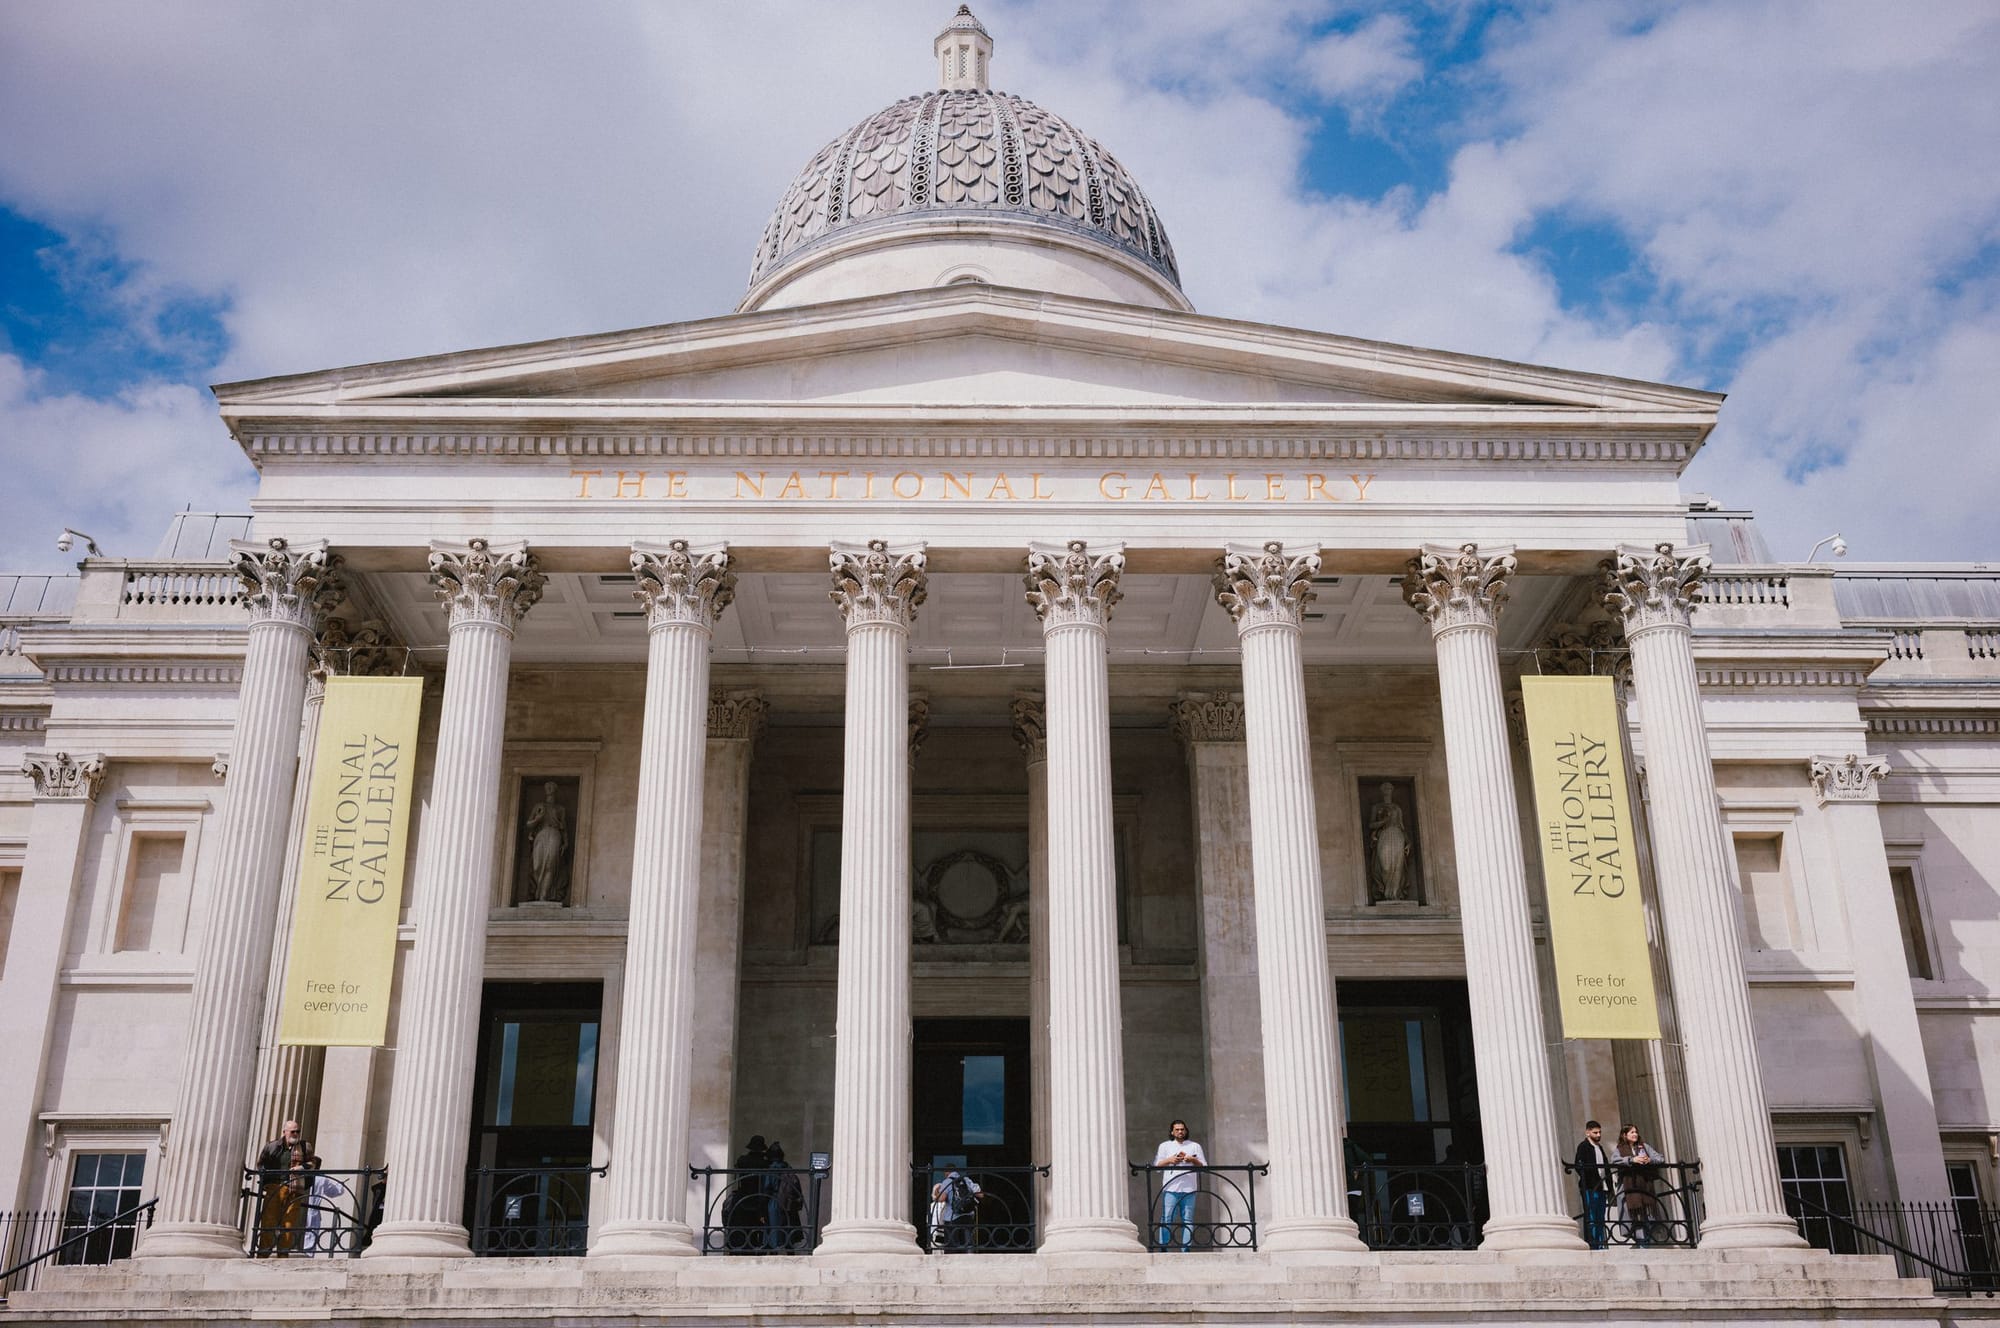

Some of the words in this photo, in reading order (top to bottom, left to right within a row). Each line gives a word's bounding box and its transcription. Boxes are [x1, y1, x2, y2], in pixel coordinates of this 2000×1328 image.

[570, 469, 688, 498] THE
[735, 470, 1054, 500] NATIONAL
[1099, 471, 1377, 501] GALLERY
[326, 734, 368, 903] NATIONAL
[356, 734, 400, 904] GALLERY
[1555, 731, 1596, 897] NATIONAL
[1580, 732, 1625, 898] GALLERY
[313, 824, 330, 858] THE
[1549, 820, 1563, 853] THE
[306, 980, 336, 994] Free
[340, 980, 361, 995] for
[1576, 974, 1604, 987] Free
[1607, 974, 1626, 987] for
[303, 1000, 369, 1015] everyone
[1578, 994, 1638, 1009] everyone
